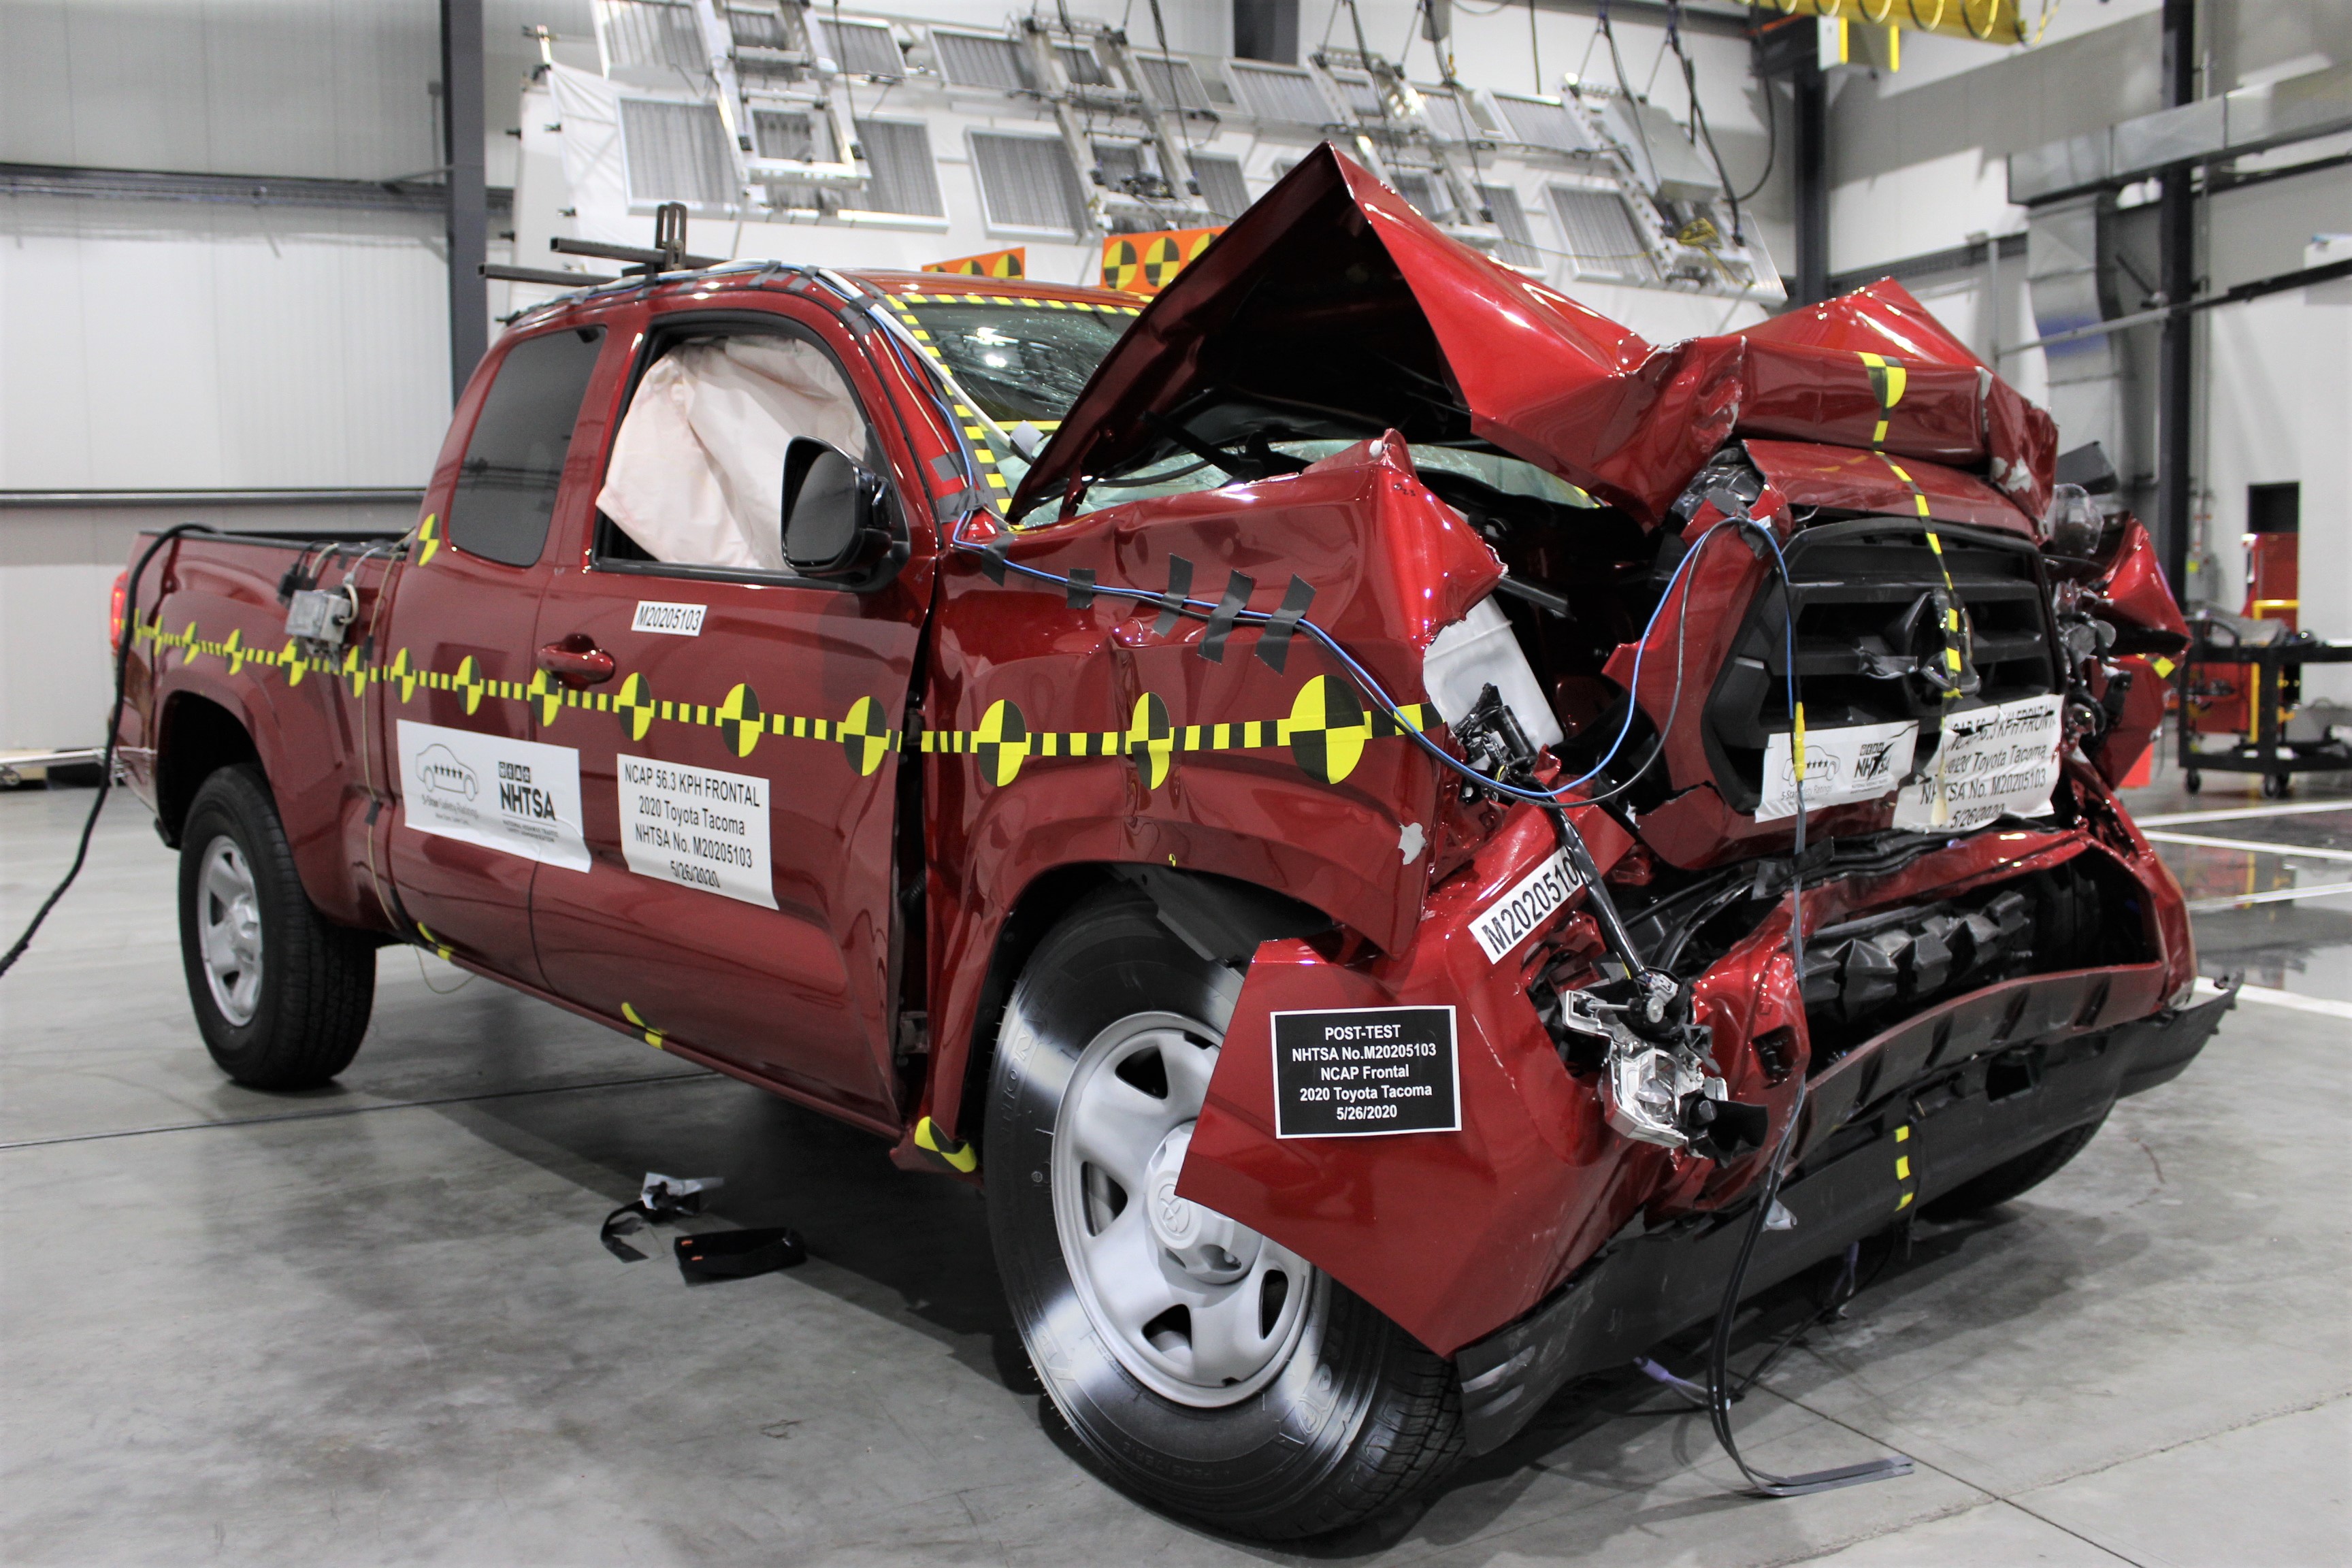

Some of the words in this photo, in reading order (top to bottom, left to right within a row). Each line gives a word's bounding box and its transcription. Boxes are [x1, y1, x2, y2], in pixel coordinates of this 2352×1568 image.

[636, 606, 701, 631] M20205103
[1944, 754, 1972, 774] 020
[1973, 749, 2007, 774] Toyota
[2010, 744, 2047, 764] Tacoma
[625, 763, 653, 786] NCAP
[655, 770, 676, 791] 56.3
[679, 772, 702, 796] KPH
[705, 777, 760, 808] FRONTAL
[1968, 778, 1987, 800] No.
[1991, 767, 2046, 796] M20205103
[499, 781, 556, 821] NHTSA
[638, 795, 662, 817] 2020
[664, 800, 700, 827] Toyota
[702, 808, 745, 836] Tacoma
[635, 822, 670, 849] NHTSA
[673, 831, 691, 853] No.
[693, 836, 753, 868] M20205103
[670, 860, 721, 888] 5/26/2020
[1481, 855, 1581, 955] M2020510
[1324, 1024, 1401, 1041] POST-TEST
[1292, 1046, 1339, 1062] NHTSA
[1320, 1066, 1360, 1081] NCAP
[1362, 1064, 1409, 1079] Frontal
[1299, 1088, 1330, 1102] 2020
[1333, 1086, 1378, 1103] Toyota
[1381, 1085, 1433, 1098] Tacoma
[1336, 1104, 1398, 1121] 5/26/2020
